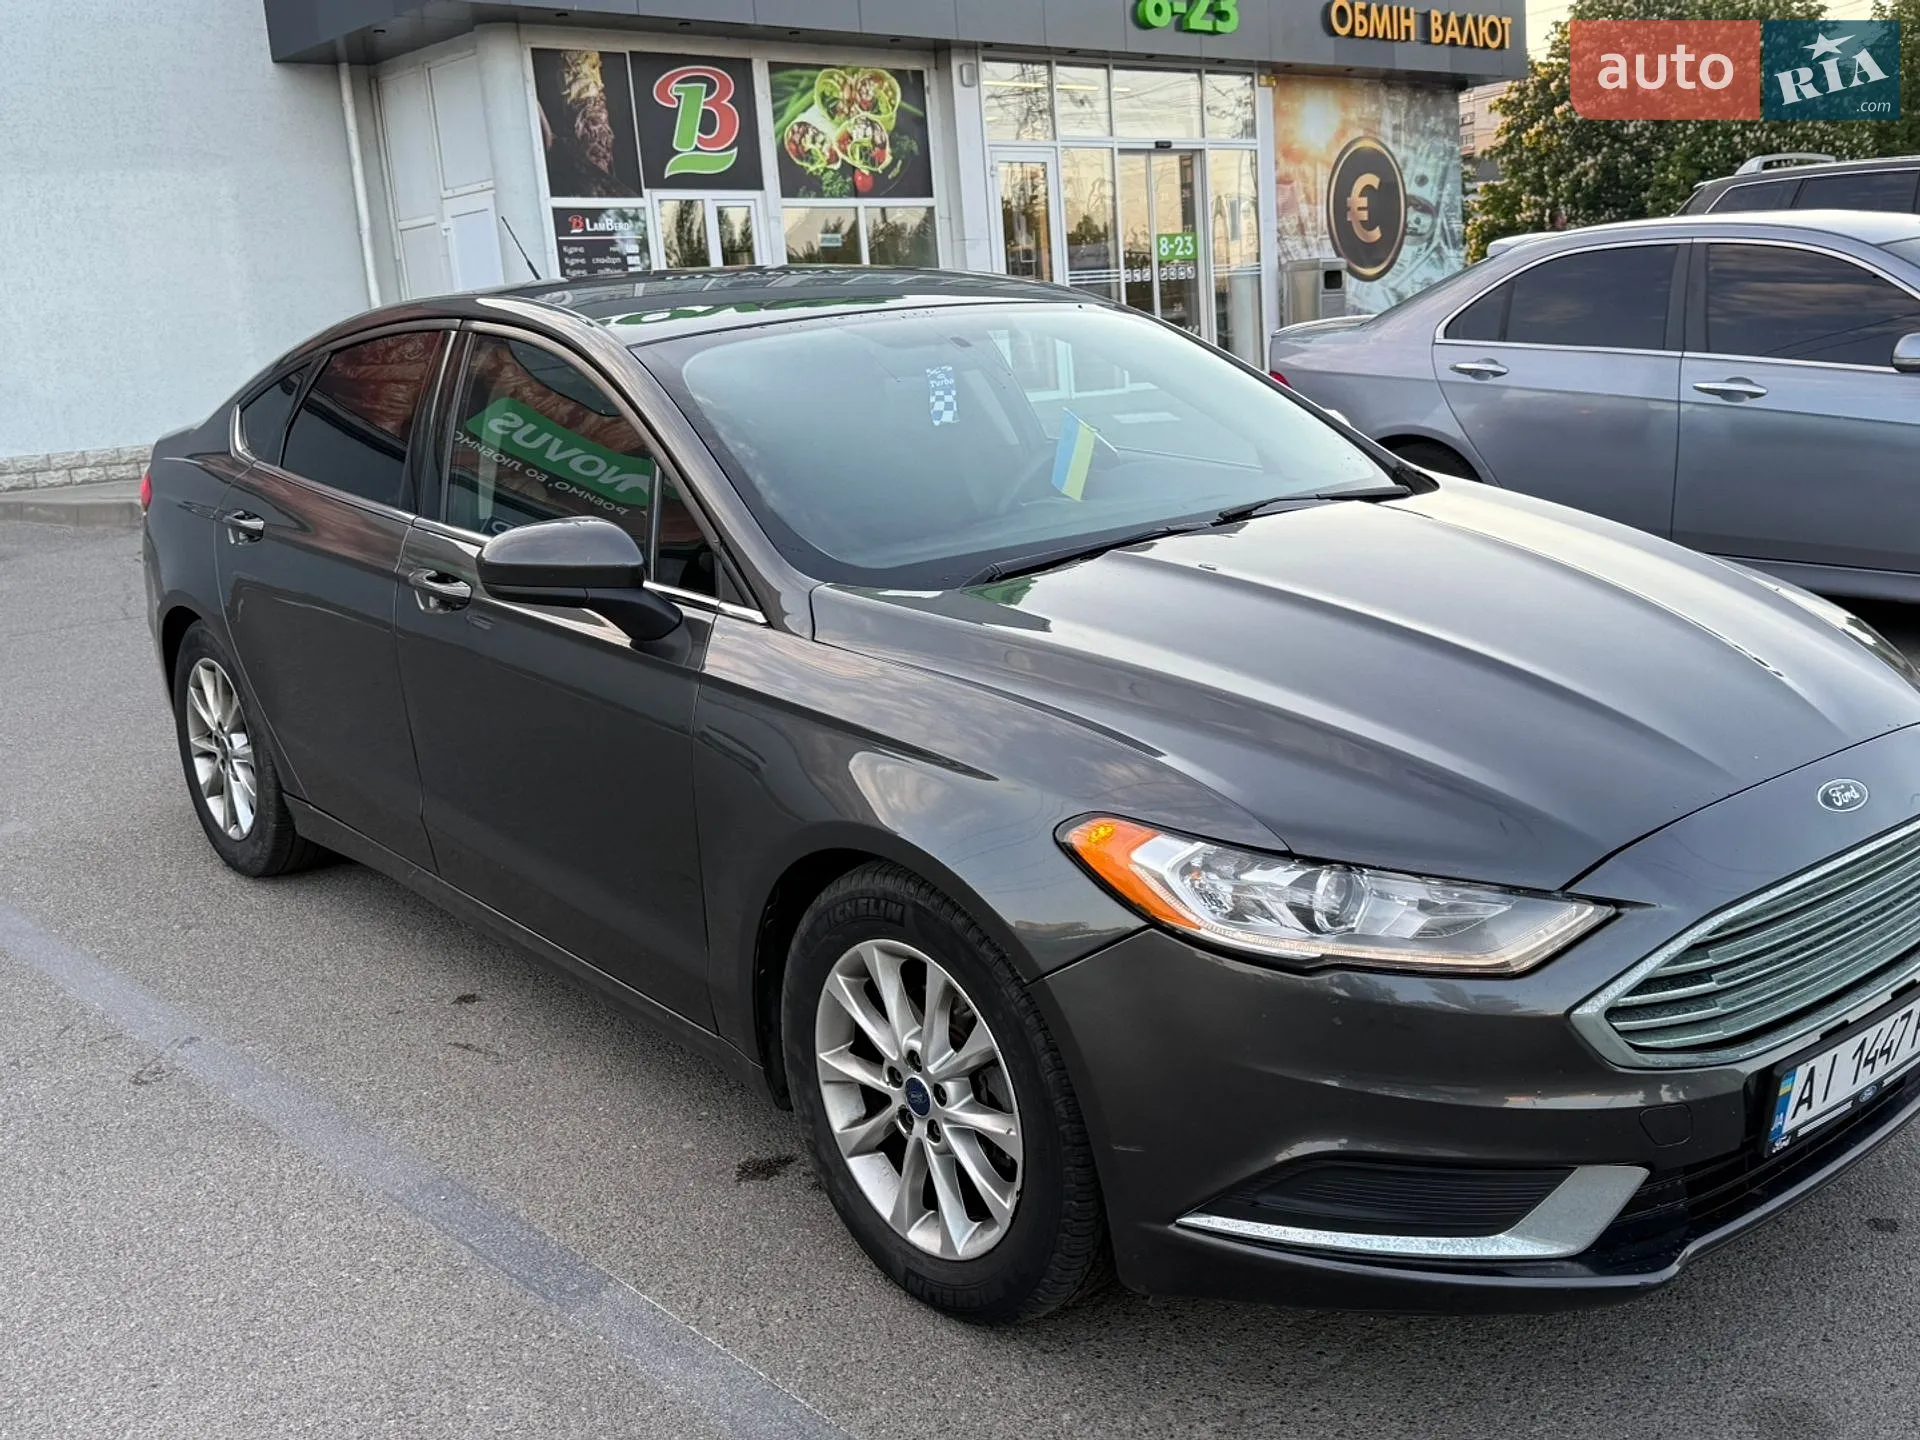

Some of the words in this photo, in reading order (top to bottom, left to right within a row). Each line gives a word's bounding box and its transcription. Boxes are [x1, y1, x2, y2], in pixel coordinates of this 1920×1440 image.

[1331, 0, 1415, 41] ОБМІН
[1430, 9, 1512, 49] ВАЛЮТ
[1159, 236, 1194, 256] 8-23
[1826, 783, 1862, 808] Ford
[1791, 1053, 1838, 1120] AI
[1852, 1008, 1914, 1085] 1447
